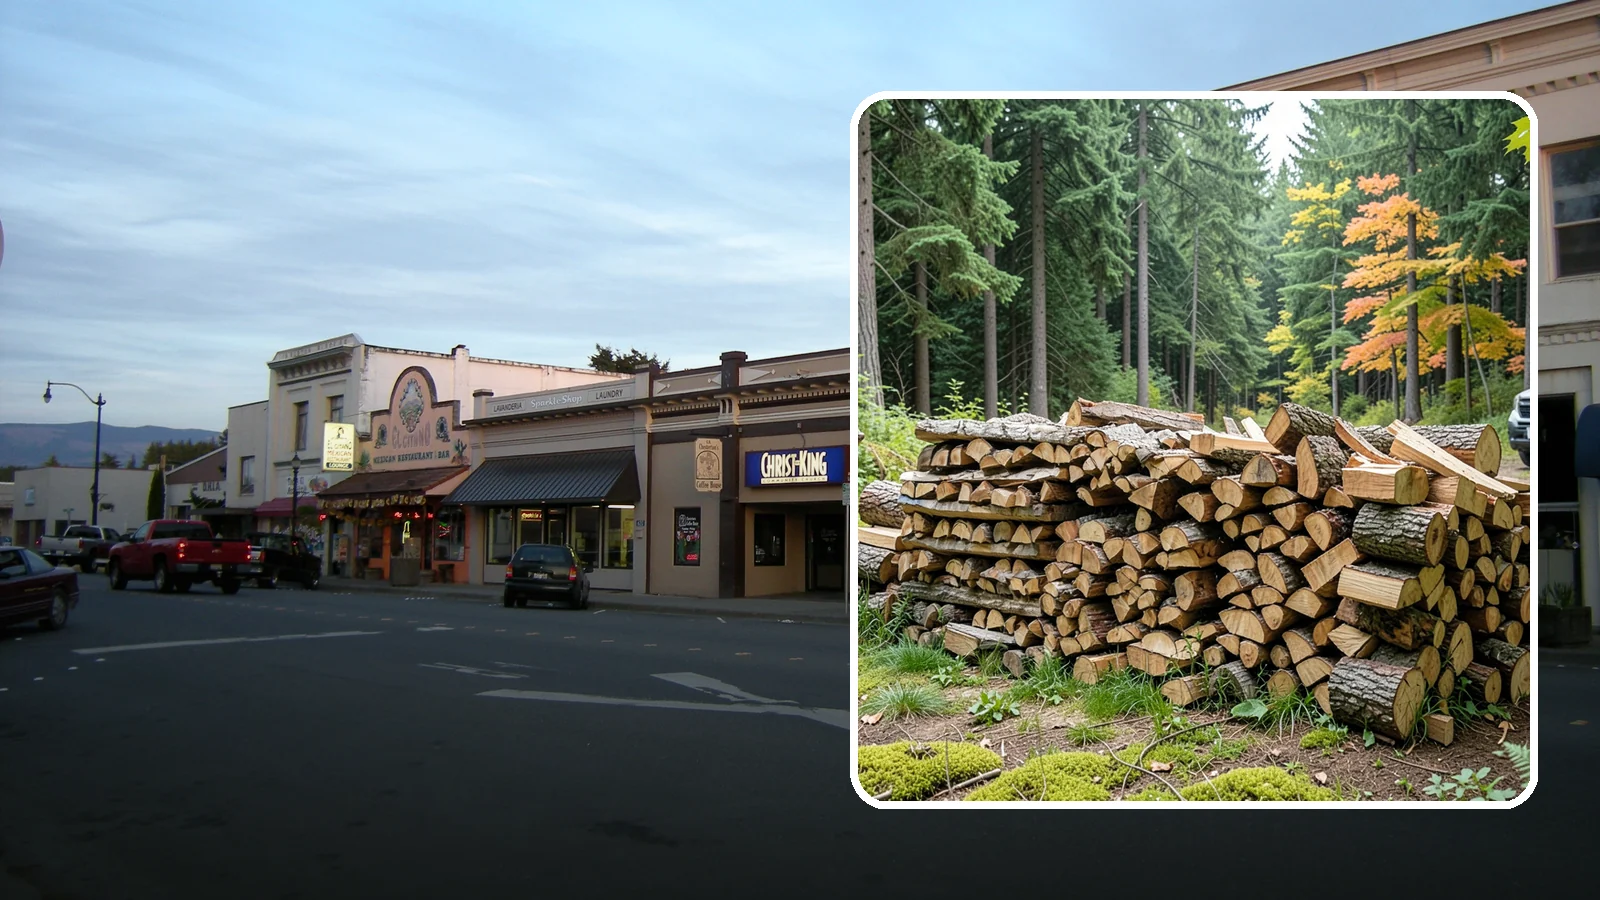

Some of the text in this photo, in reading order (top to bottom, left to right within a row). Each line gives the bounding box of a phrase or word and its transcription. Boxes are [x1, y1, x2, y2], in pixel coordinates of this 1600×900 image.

[562, 394, 583, 404] Shop
[595, 389, 623, 399] LAUNDRY
[494, 402, 522, 412] LAVANDERIA
[374, 455, 396, 464] MEXICAN
[397, 451, 433, 461] RESTAURANT
[438, 450, 450, 459] BAR
[761, 450, 827, 478] CHRIST KING
[696, 480, 722, 488] Coffee House
